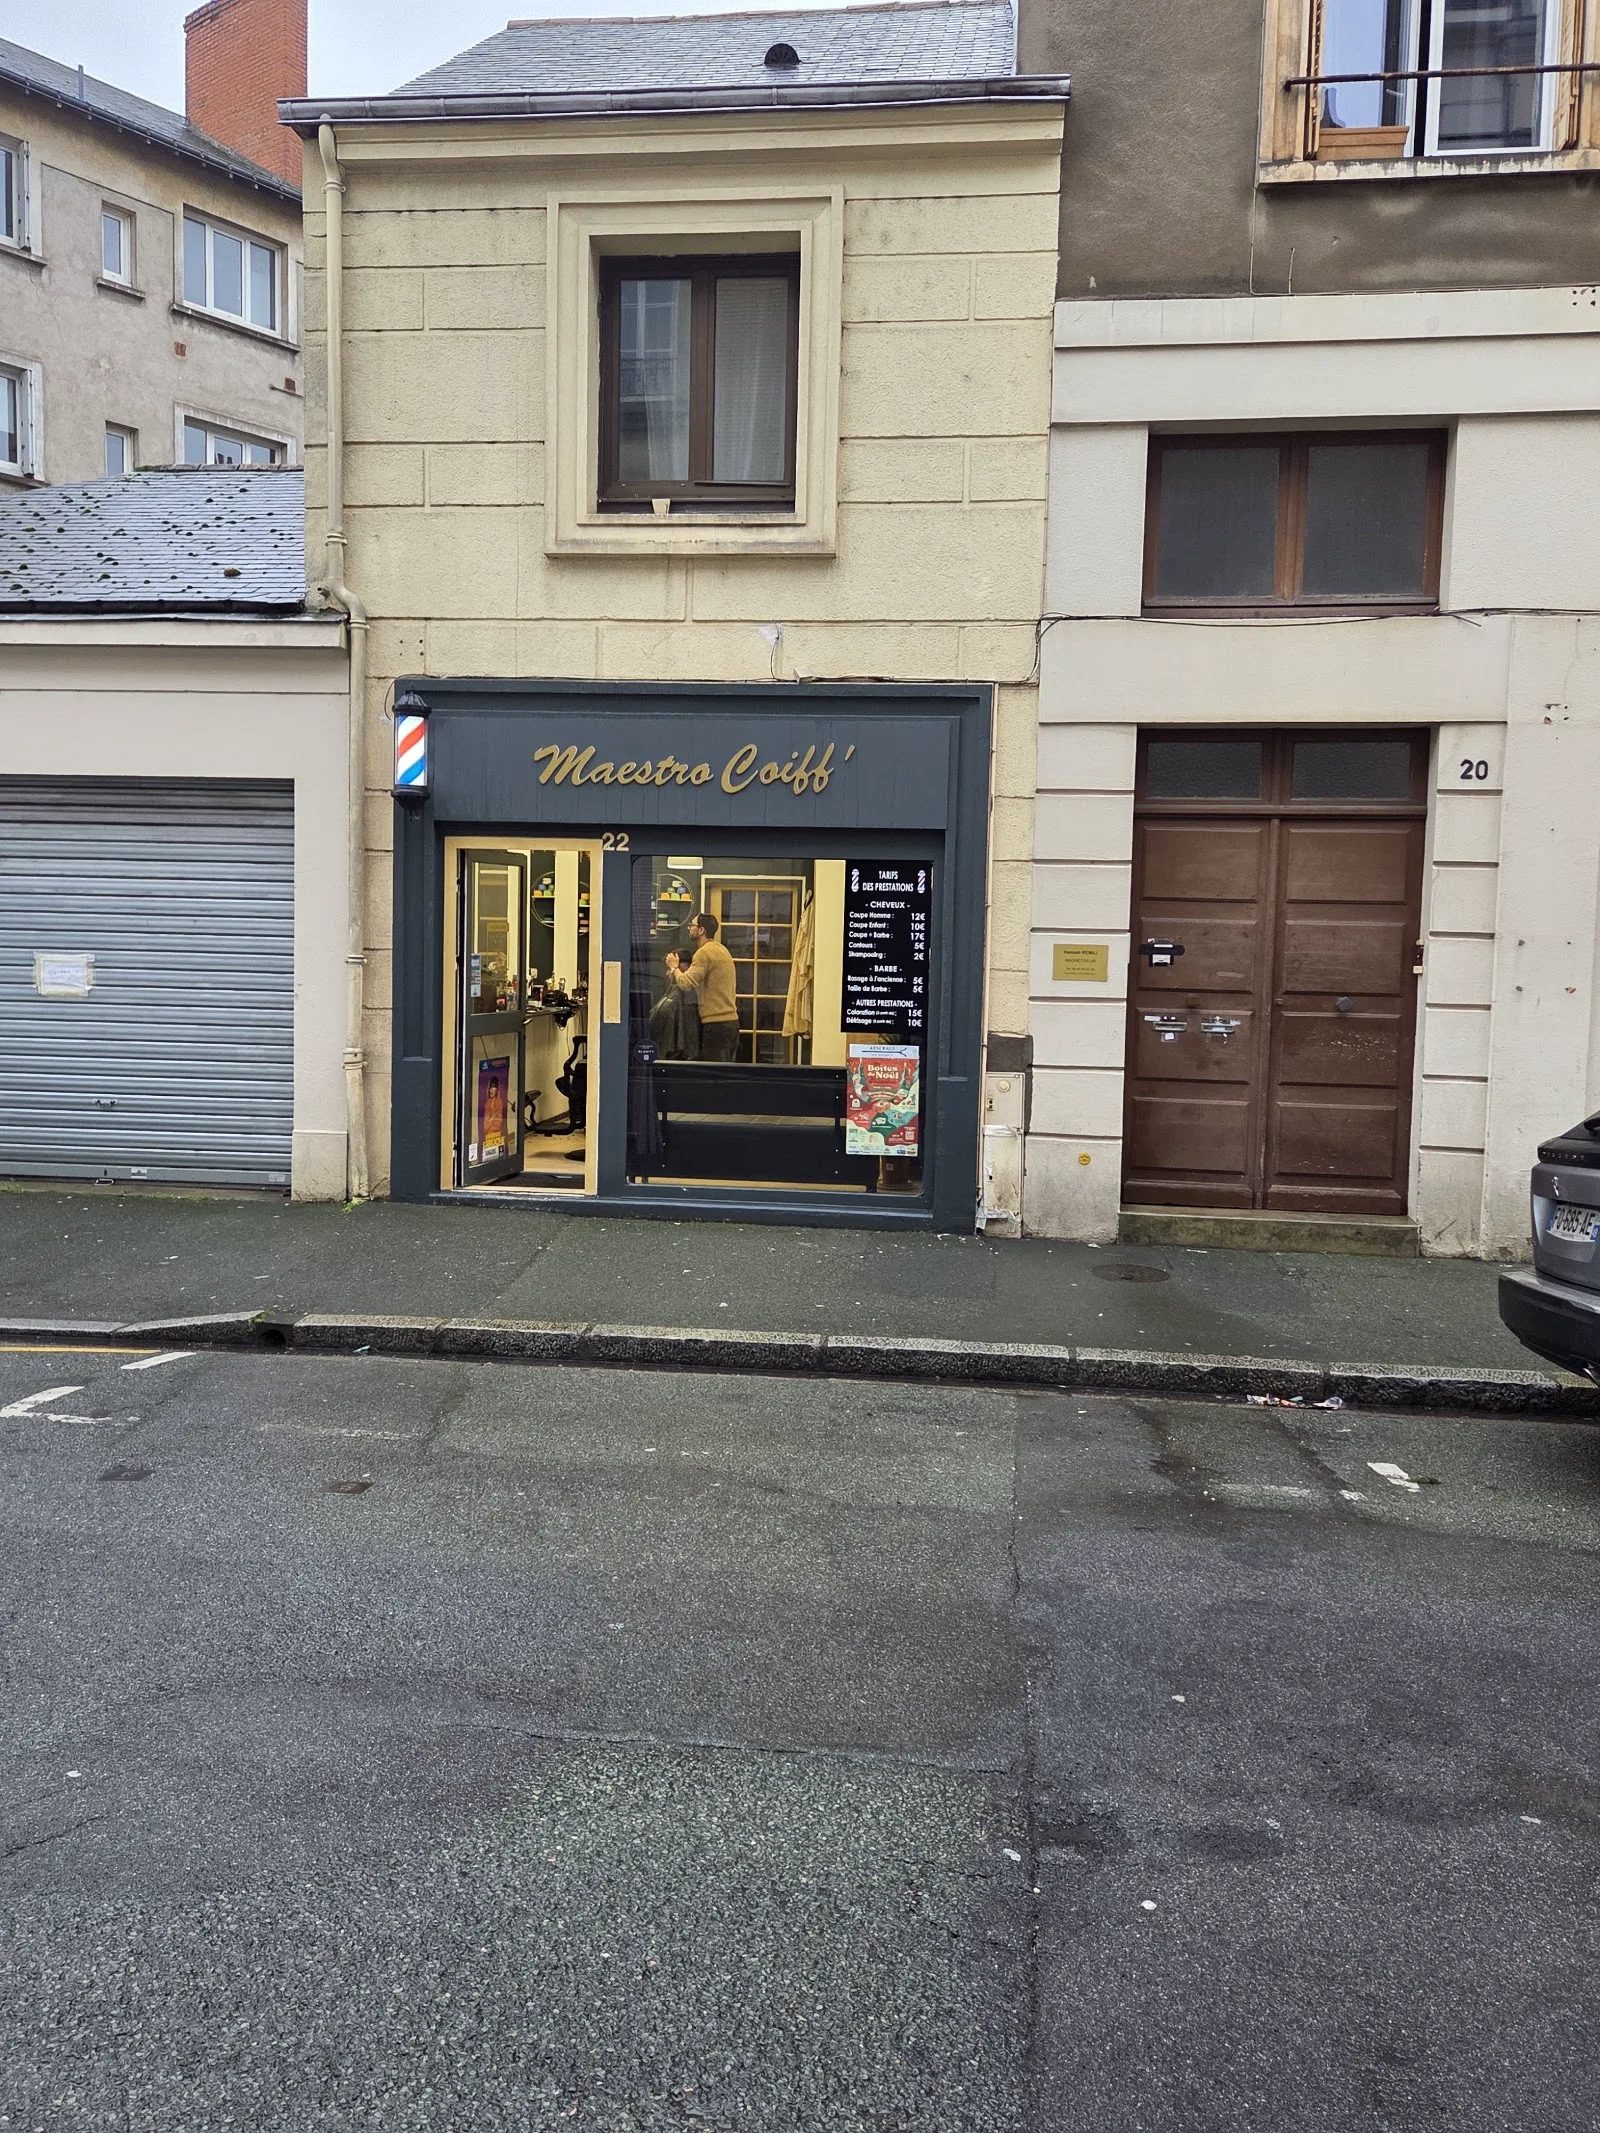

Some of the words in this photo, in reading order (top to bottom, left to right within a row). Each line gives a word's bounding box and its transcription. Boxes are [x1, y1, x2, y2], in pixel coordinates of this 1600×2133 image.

[533, 743, 714, 786] Maestro
[1460, 759, 1488, 780] 20
[602, 832, 630, 851] 22
[878, 870, 898, 880] TARIFS
[862, 882, 874, 891] DES
[875, 882, 914, 892] PRESTATIONS
[849, 911, 868, 919] Coupe
[849, 921, 868, 929] Coupe
[911, 922, 925, 930] 10€
[849, 931, 867, 939] Coupe
[910, 932, 925, 940] 17€
[847, 975, 868, 983] Rasage
[913, 985, 923, 993] 5€
[908, 1009, 922, 1017] 15€
[868, 1064, 897, 1072] Boîtes
[875, 1071, 899, 1079] Noël
